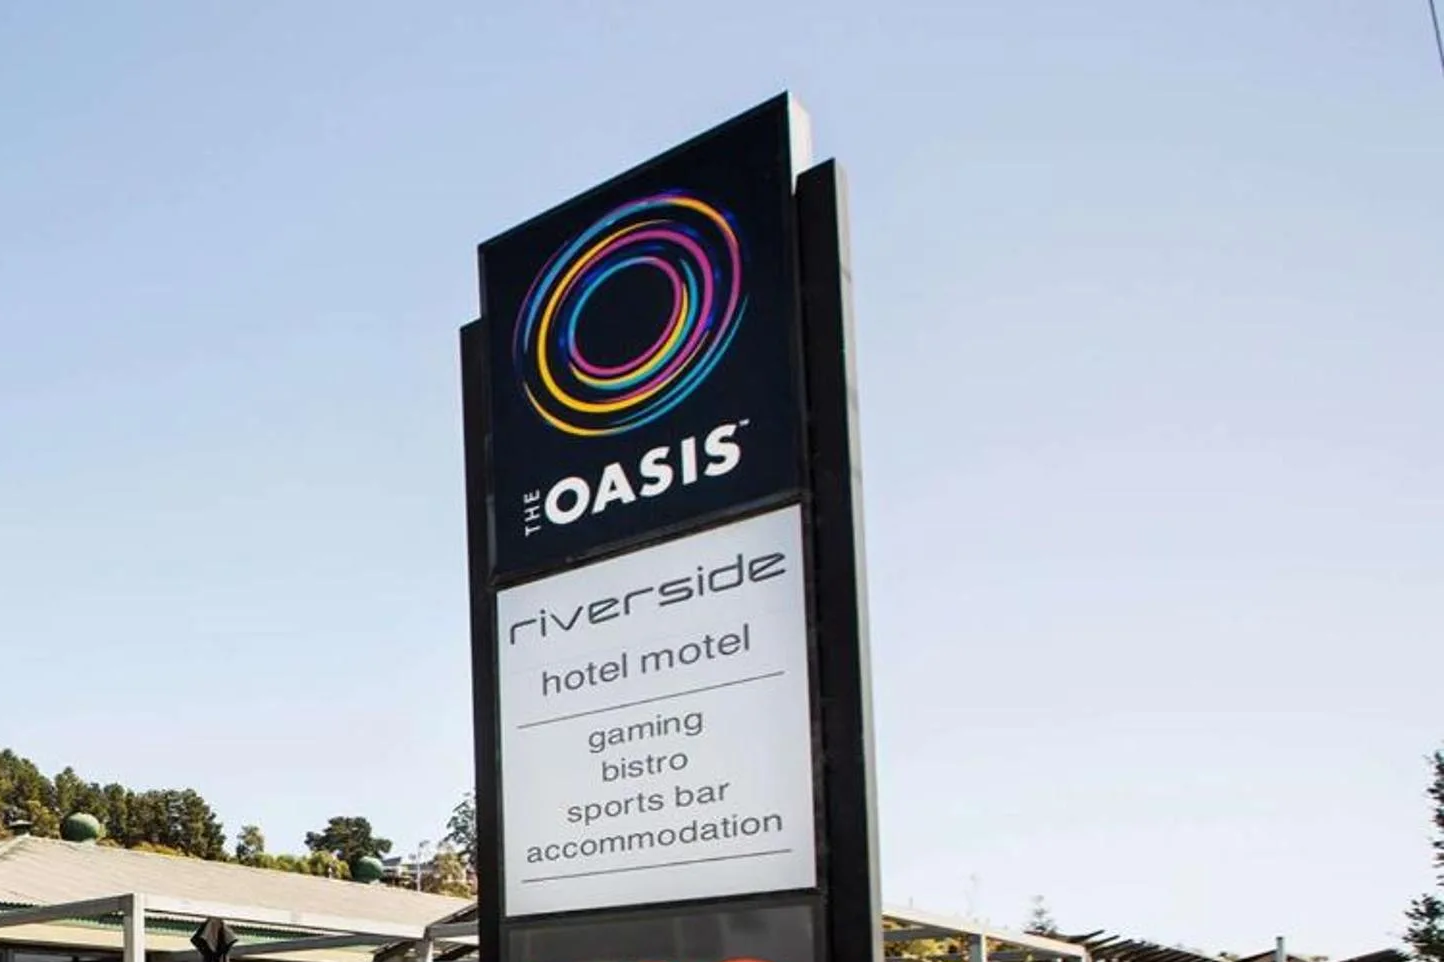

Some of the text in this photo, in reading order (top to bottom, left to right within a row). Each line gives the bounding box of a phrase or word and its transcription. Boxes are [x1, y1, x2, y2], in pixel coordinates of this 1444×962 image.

[523, 424, 742, 537] THE OASIS
[509, 551, 786, 645] riverside
[542, 623, 751, 696] hotel motel
[588, 711, 704, 754] gaming
[601, 752, 689, 782] bistro
[567, 781, 731, 826] sports bar
[526, 813, 783, 864] accommodation
